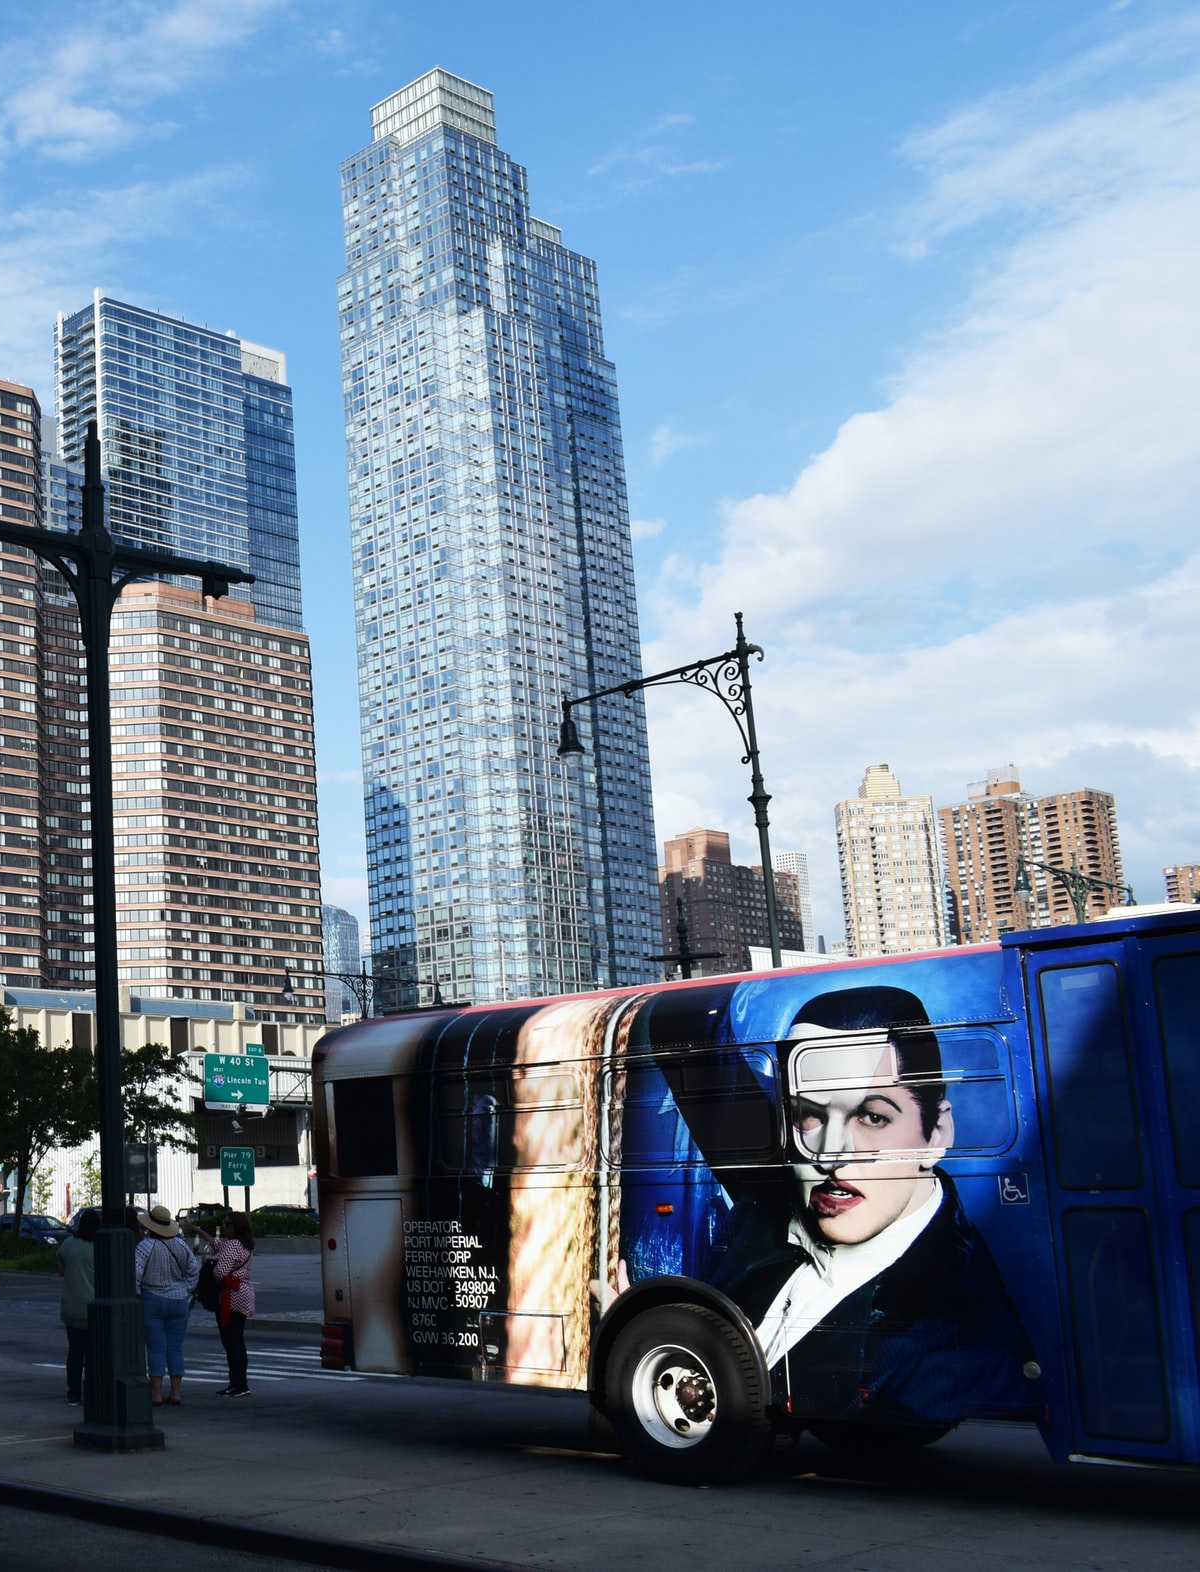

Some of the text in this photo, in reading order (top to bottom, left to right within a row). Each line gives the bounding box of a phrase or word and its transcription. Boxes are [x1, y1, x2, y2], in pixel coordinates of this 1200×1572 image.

[219, 1056, 254, 1067] W 40 St
[227, 1076, 267, 1086] Lincoln Tun
[228, 1162, 248, 1170] Ferry
[404, 1221, 462, 1233] OPERATOR:
[405, 1236, 482, 1248] PORT IMPERIAL
[406, 1251, 471, 1263] FERRY CORP
[406, 1266, 498, 1280] WEEHAWKEN, N.J.
[407, 1281, 421, 1293] US
[423, 1281, 445, 1294] DOT
[455, 1281, 496, 1295] 349804
[408, 1297, 420, 1309] NJ
[422, 1297, 449, 1310] MVC
[456, 1295, 489, 1309] 50907
[412, 1313, 437, 1327] 876C
[413, 1331, 479, 1347] GVW 36,200
